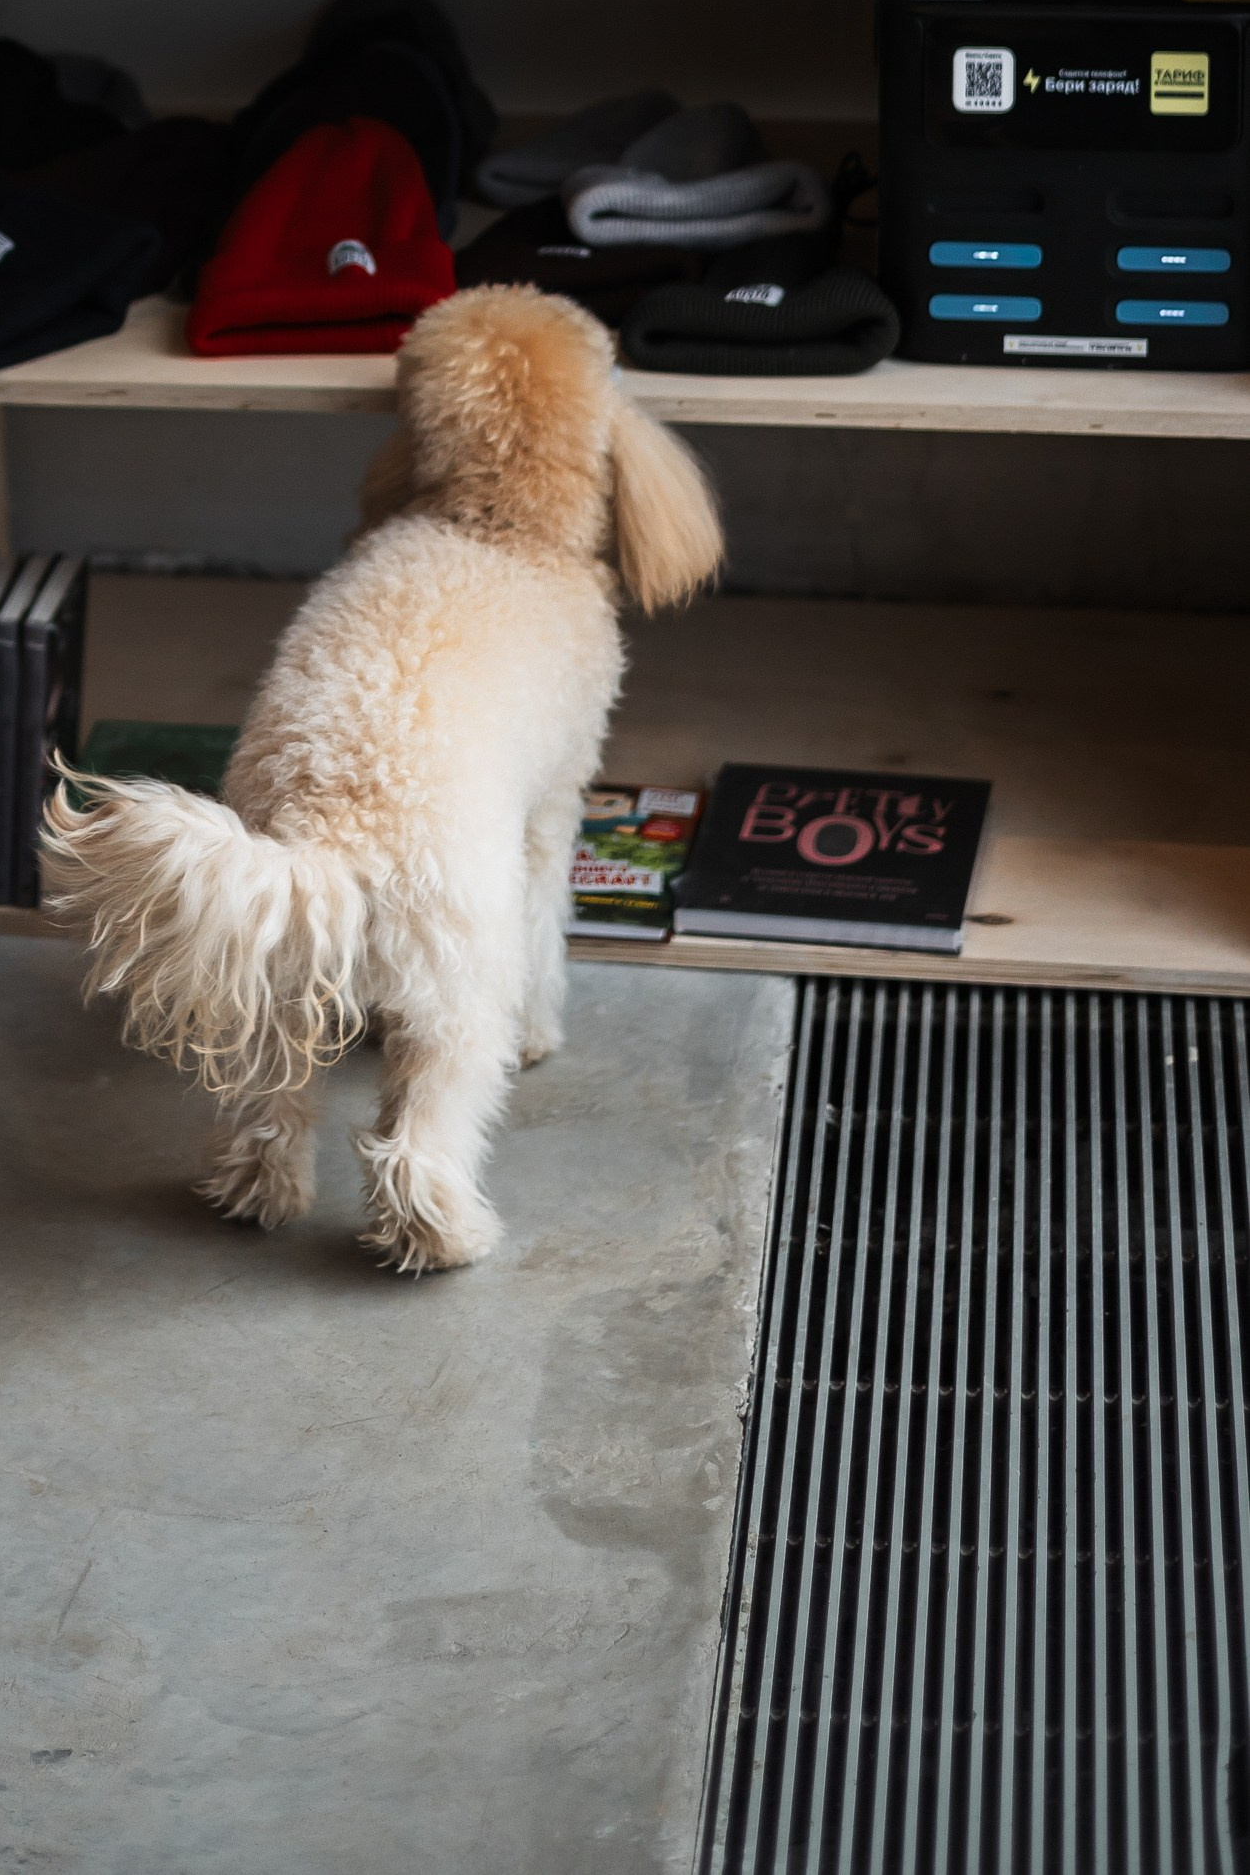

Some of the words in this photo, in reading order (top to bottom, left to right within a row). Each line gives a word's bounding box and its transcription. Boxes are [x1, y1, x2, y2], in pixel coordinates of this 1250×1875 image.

[1154, 68, 1205, 81] ТАРИФ
[1044, 76, 1086, 95] Бери
[1088, 77, 1140, 96] заряд!
[738, 804, 947, 867] BOYS
